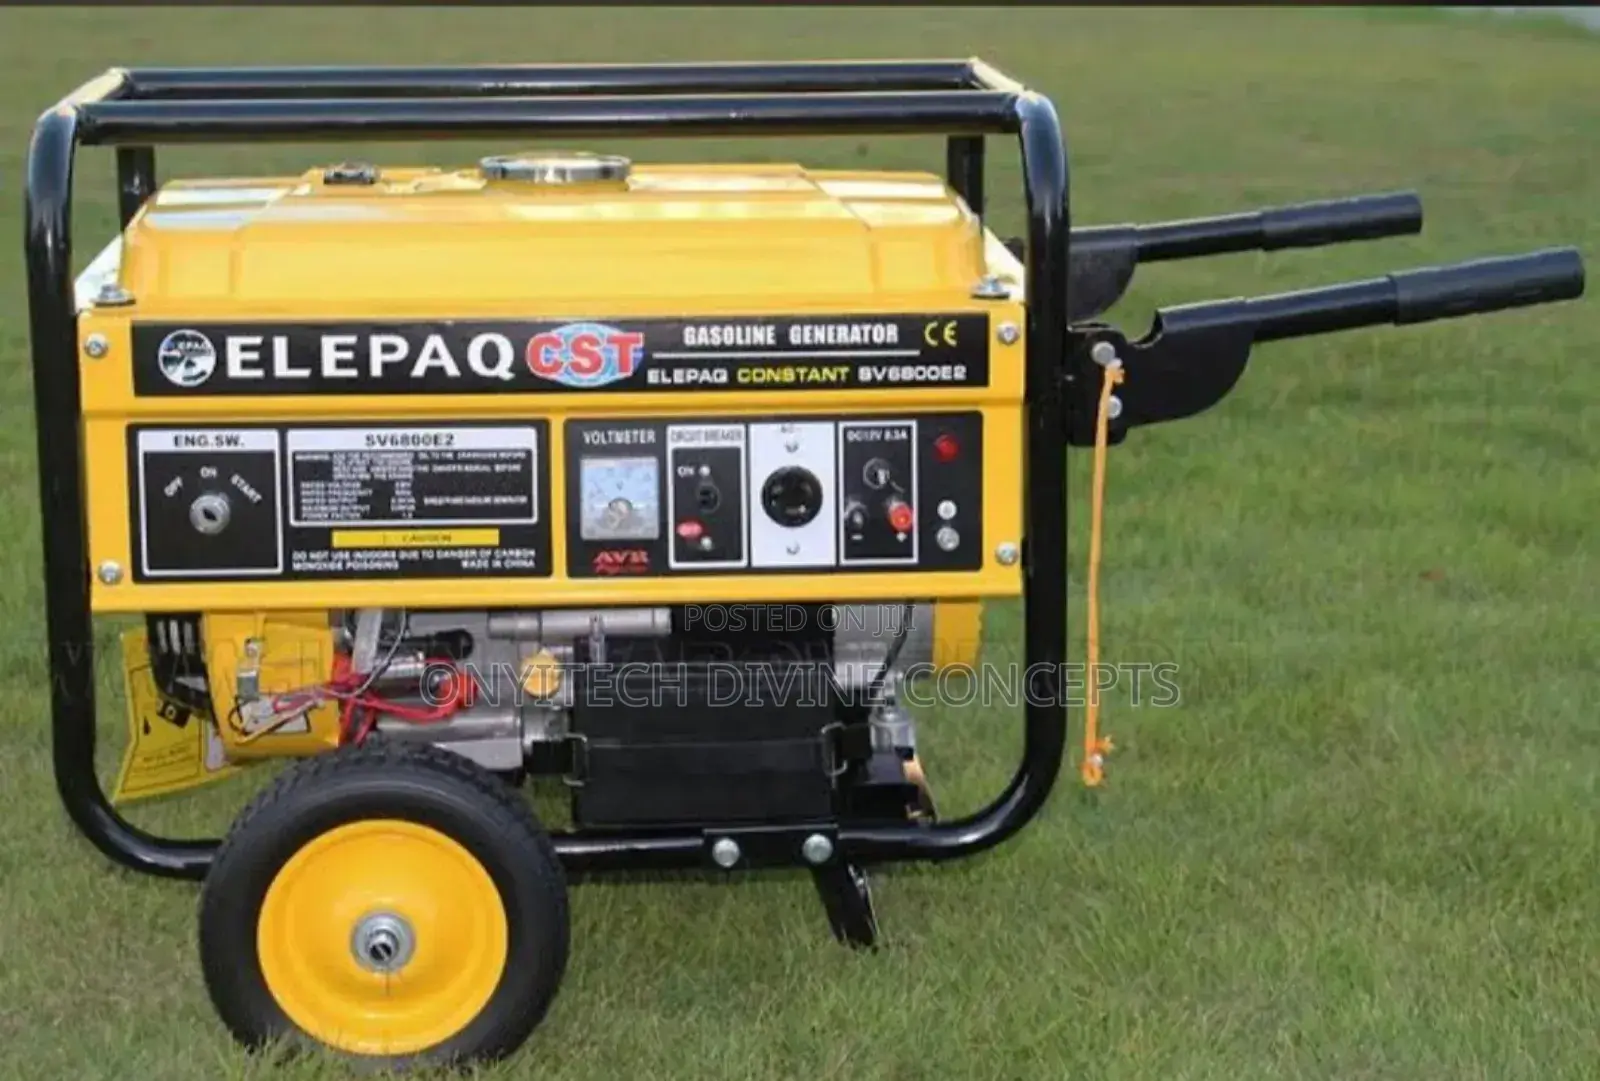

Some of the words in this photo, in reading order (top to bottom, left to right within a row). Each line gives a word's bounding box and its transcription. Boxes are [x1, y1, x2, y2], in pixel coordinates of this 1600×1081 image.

[683, 324, 776, 347] GASOLINE
[789, 322, 899, 345] GENERATOR
[225, 332, 515, 381] ELEPAQ
[526, 331, 645, 378] CST
[646, 366, 729, 385] ELEPAQ
[736, 365, 850, 384] CONSTANT
[364, 432, 455, 448] SV6800E2
[582, 428, 656, 445] VOLTMETER
[704, 428, 743, 442] BREAKER
[199, 465, 218, 478] ON
[676, 465, 695, 478] ON
[230, 473, 263, 504] START
[308, 549, 330, 562] NOT
[421, 548, 435, 561] TO
[436, 547, 478, 560] DANGER
[493, 546, 536, 559] CARBON
